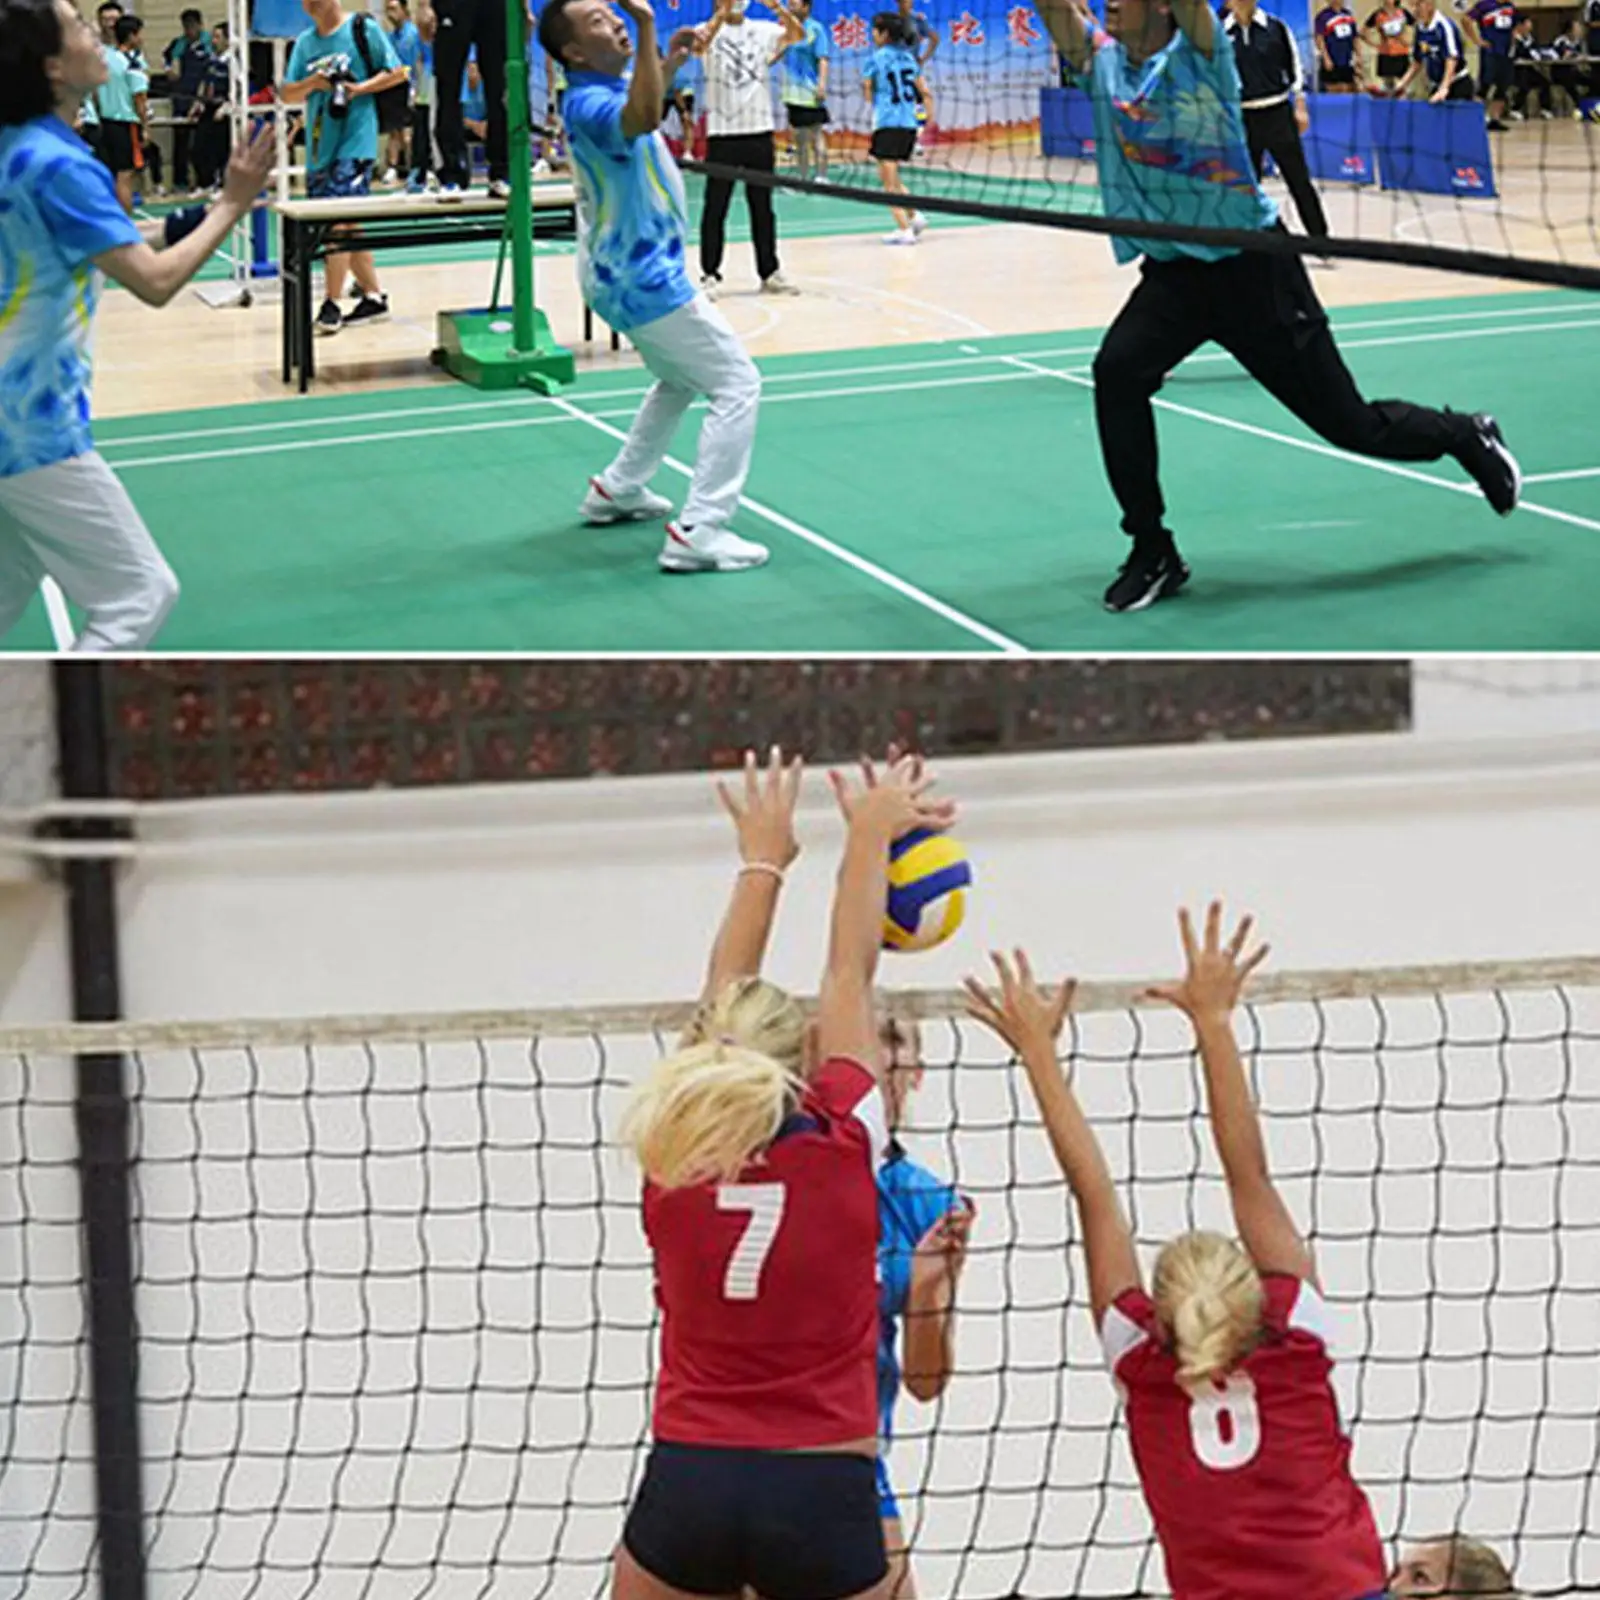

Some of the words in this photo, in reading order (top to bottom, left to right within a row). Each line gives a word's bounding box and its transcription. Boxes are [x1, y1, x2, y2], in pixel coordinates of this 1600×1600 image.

[886, 68, 923, 105] 15
[716, 1181, 786, 1299] 7
[1178, 1367, 1261, 1470] 8
